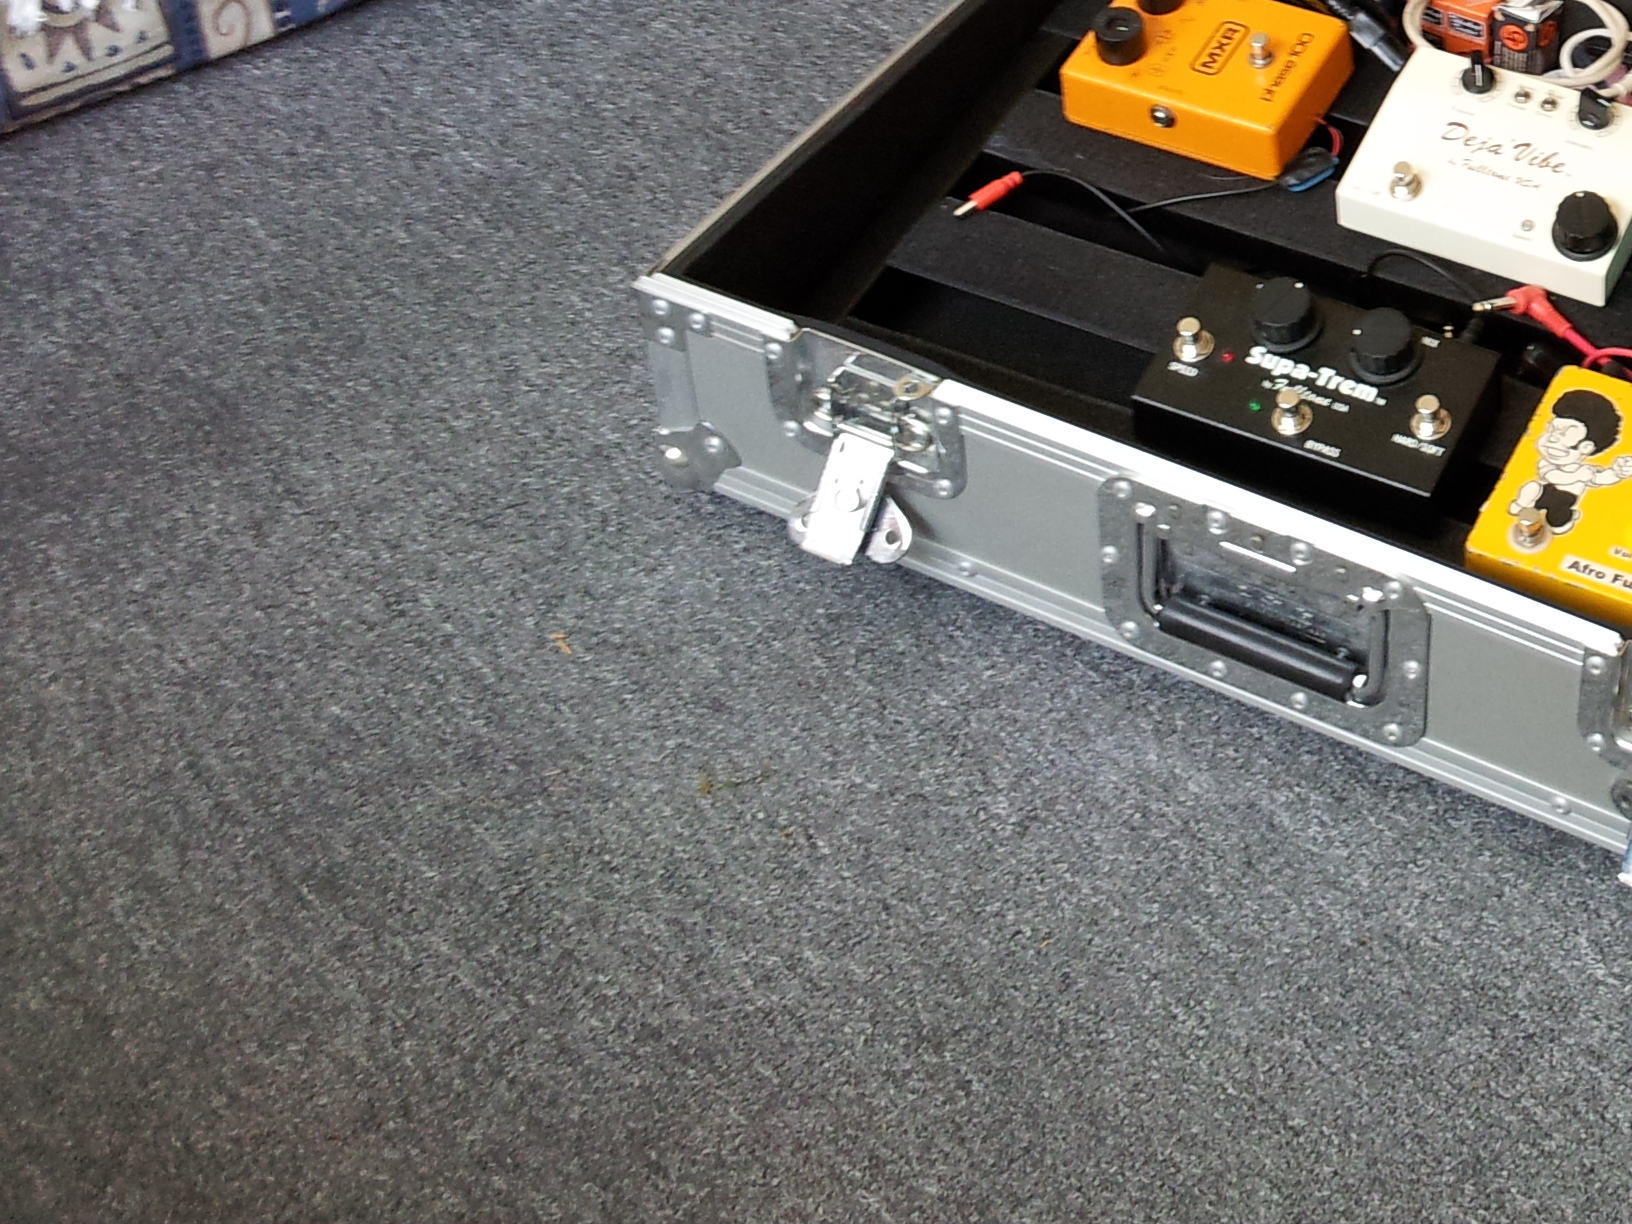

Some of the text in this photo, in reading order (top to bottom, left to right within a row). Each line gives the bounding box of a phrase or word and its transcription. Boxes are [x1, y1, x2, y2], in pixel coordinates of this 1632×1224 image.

[1202, 27, 1241, 70] MXR
[1260, 32, 1315, 103] phase 100
[1513, 141, 1566, 174] Vibe
[1245, 345, 1380, 403] Supa-Trem
[1303, 439, 1342, 458] BYPASS
[1568, 559, 1606, 581] Afro
